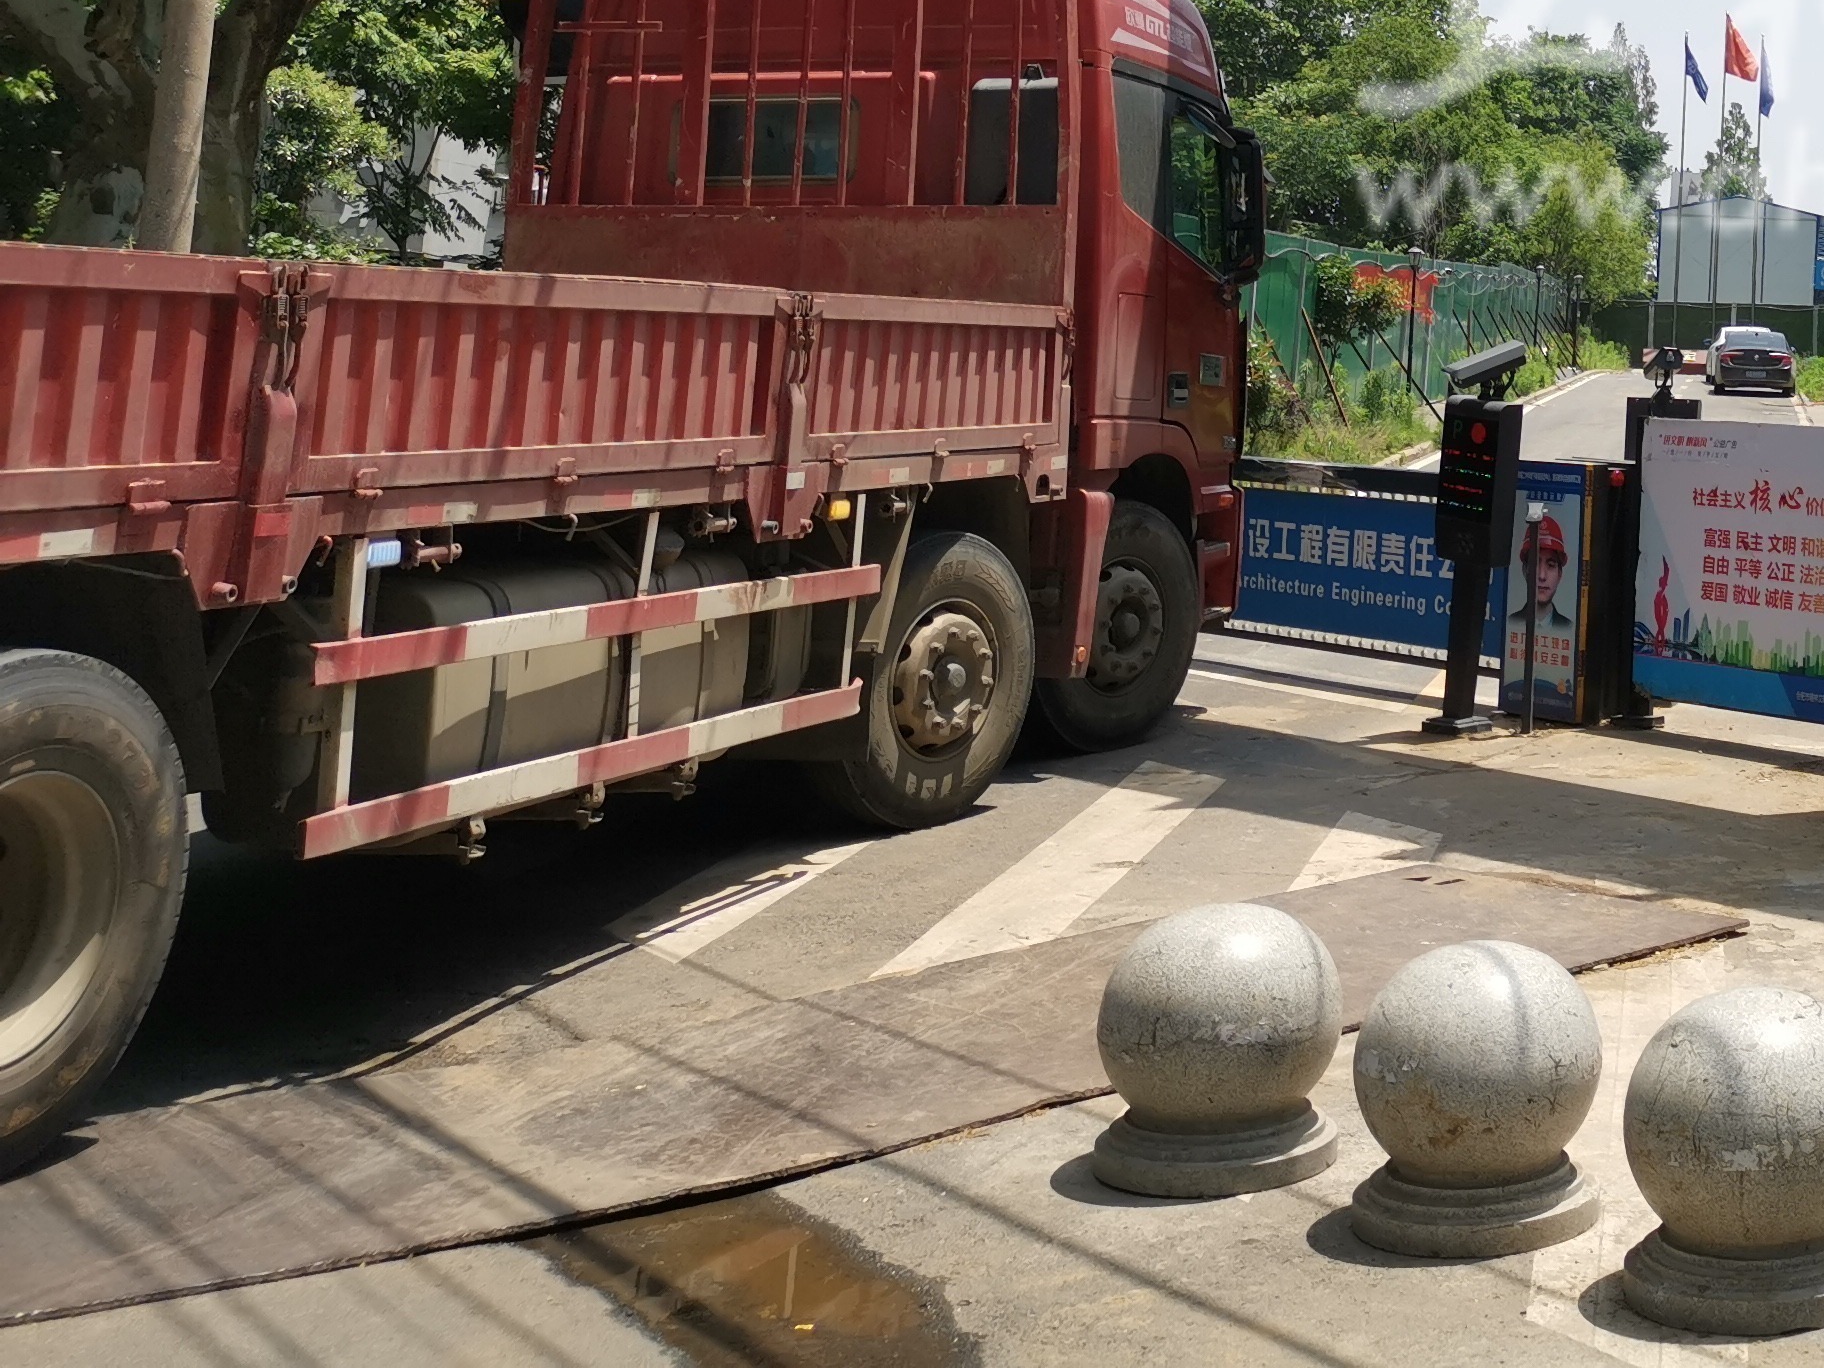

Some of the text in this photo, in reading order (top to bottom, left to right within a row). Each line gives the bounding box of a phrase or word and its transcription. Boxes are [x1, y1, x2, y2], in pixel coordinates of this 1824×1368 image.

[1704, 528, 1731, 550] 富强
[1736, 531, 1763, 552] 民主
[1767, 534, 1796, 555] 文明
[1703, 555, 1729, 576] 自由
[1734, 558, 1762, 579] 平等
[1766, 561, 1795, 583] 公正
[1332, 583, 1426, 616] Engineering
[1701, 581, 1728, 602] 爱国
[1733, 584, 1760, 606] 敬业
[1765, 588, 1794, 610] 诚信
